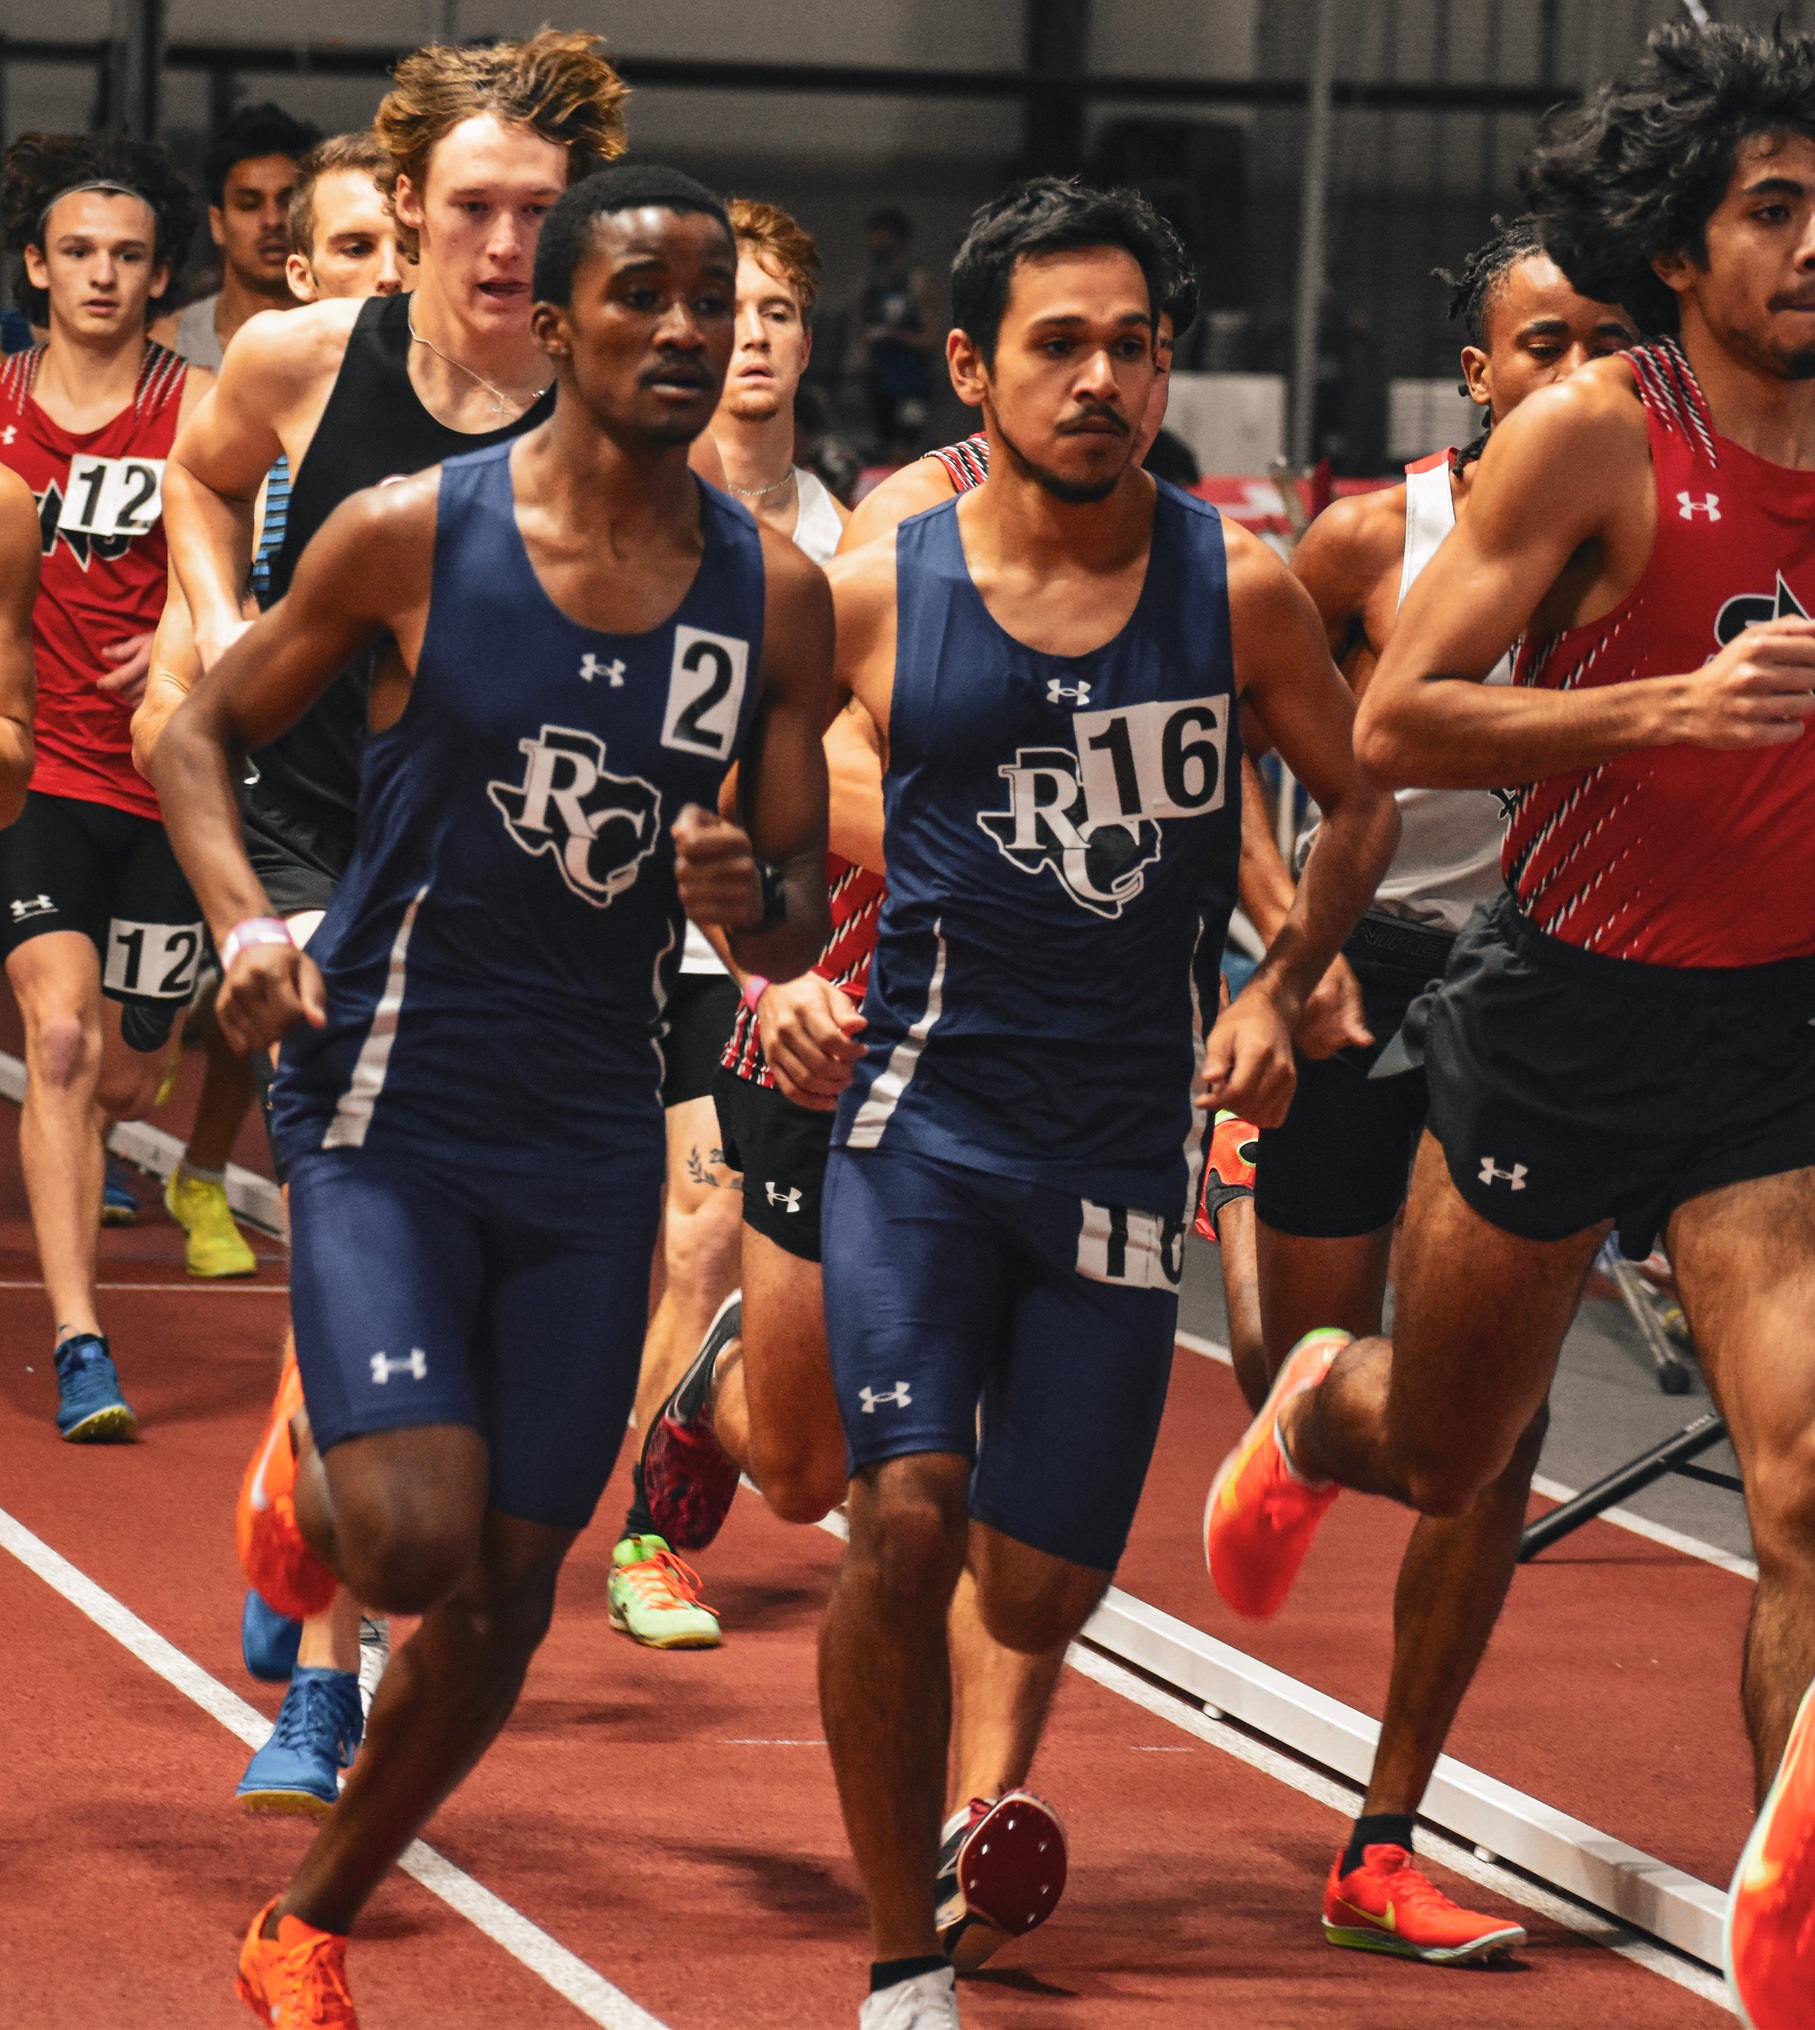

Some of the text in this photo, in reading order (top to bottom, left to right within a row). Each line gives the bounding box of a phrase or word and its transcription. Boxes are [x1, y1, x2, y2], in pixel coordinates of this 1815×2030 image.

[79, 465, 157, 528] 12
[672, 641, 730, 750] 2
[1088, 706, 1219, 816] 16
[116, 928, 197, 992] 12
